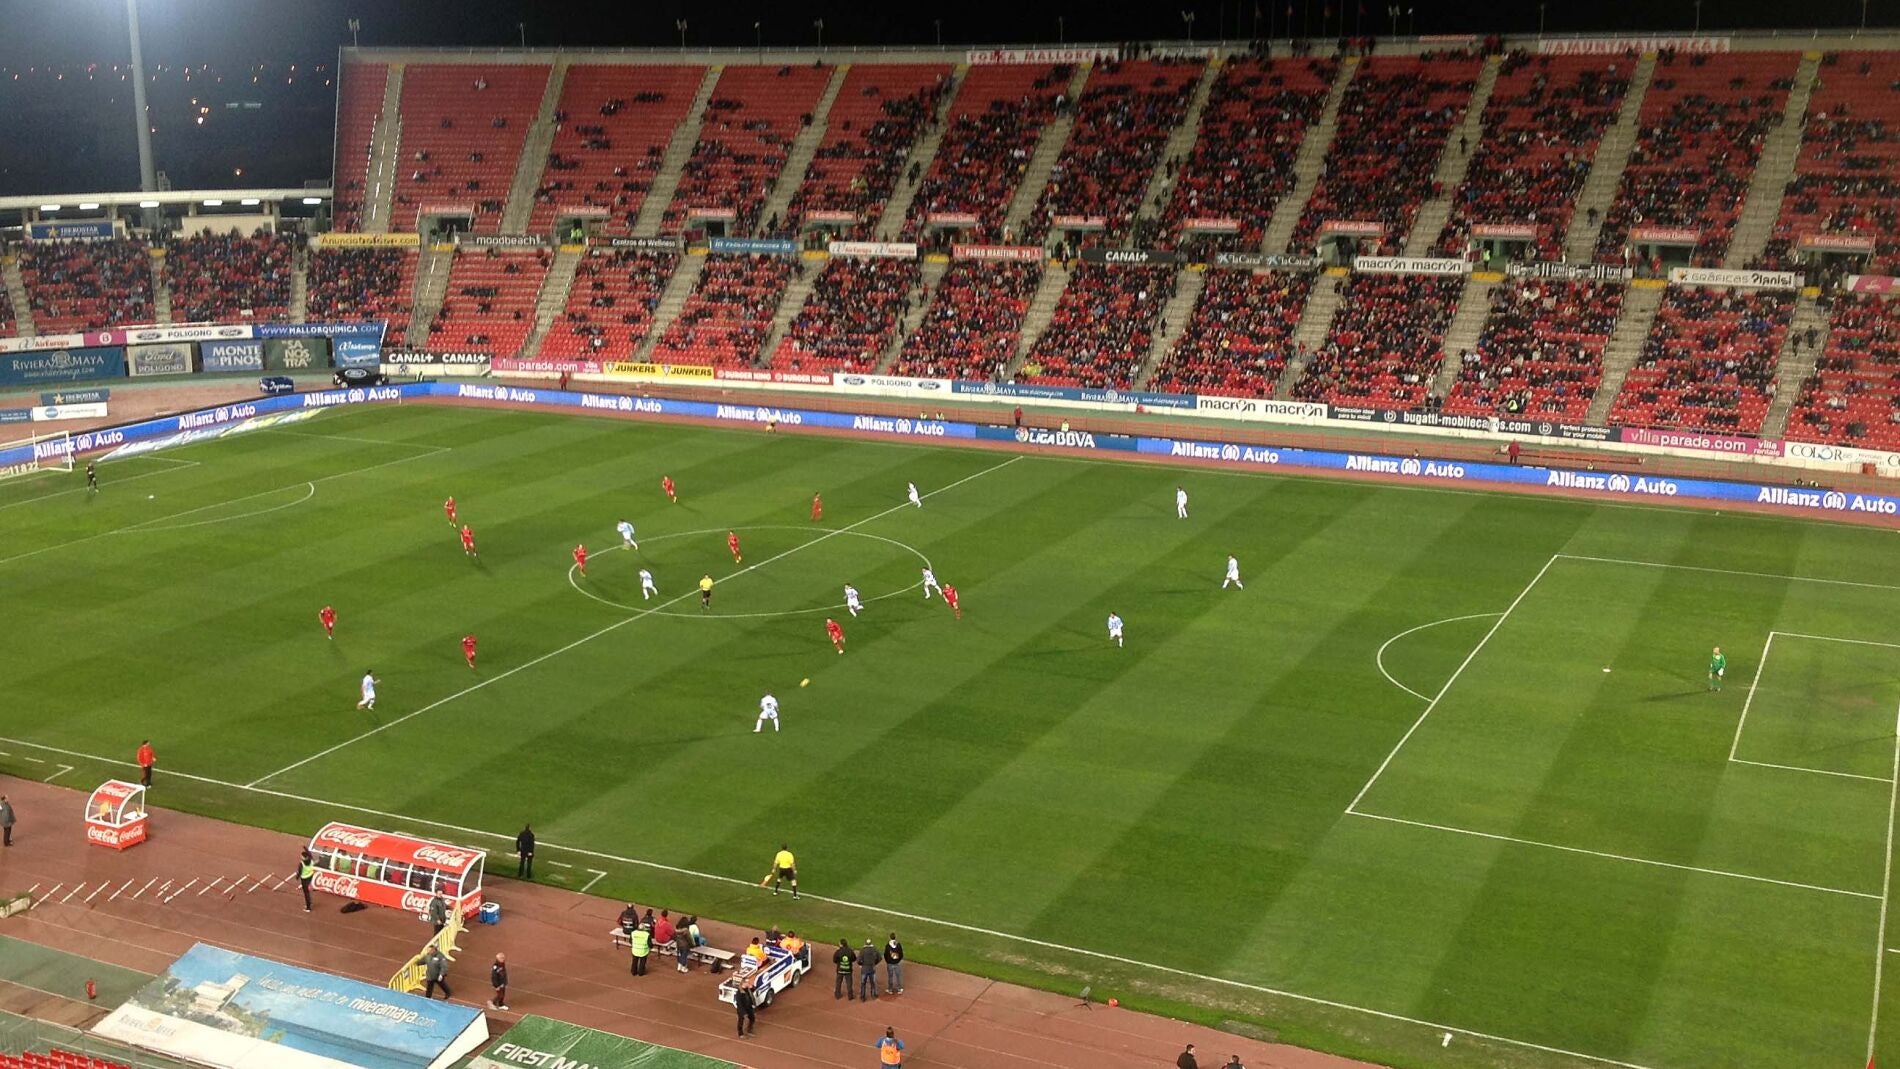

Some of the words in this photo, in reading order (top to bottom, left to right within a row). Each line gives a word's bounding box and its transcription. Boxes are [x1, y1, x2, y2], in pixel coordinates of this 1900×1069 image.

[476, 235, 536, 246] moodbeach
[1105, 251, 1149, 262] CANAL+
[1358, 259, 1406, 271] macron
[1411, 260, 1461, 272] macron
[212, 344, 261, 357] MONTE
[284, 349, 310, 359] NOS
[388, 353, 434, 363] CANAL+
[442, 353, 487, 363] CANAL+
[71, 354, 105, 367] MAYA
[614, 364, 656, 374] JUNKERS
[670, 366, 713, 377] JUNKERS
[753, 372, 771, 381] KING
[871, 378, 912, 388] POLIGONO
[303, 391, 346, 407] Allianz
[368, 387, 400, 401] Auto
[459, 384, 494, 400] Allianz
[510, 388, 536, 402] Auto
[581, 394, 617, 410] Allianz
[634, 398, 662, 413] Auto
[1200, 398, 1256, 412] macron
[1265, 402, 1323, 417] macron
[178, 409, 214, 430] Allianz
[231, 405, 256, 420] Auto
[717, 405, 755, 421] Allianz
[774, 410, 802, 424] Auto
[853, 416, 894, 432] Allianz
[914, 420, 945, 436] Auto
[34, 441, 76, 459] Allianz
[95, 431, 124, 447] Auto
[1630, 429, 1746, 451] villaparade.com
[1757, 439, 1777, 449] villa
[1171, 440, 1219, 458] Allianz
[1242, 449, 1279, 464] Auto
[1791, 444, 1843, 461] COLOR
[1346, 455, 1399, 474] Allianz
[1423, 461, 1465, 479] Auto
[1546, 470, 1605, 490] Allianz
[1633, 477, 1677, 496] Auto
[1757, 486, 1820, 508] Allianz
[1850, 494, 1898, 515] Auto
[320, 827, 380, 848] Coca-Cola
[412, 845, 476, 867] Coca-Cola
[311, 870, 360, 897] Coca-Cola
[492, 1042, 557, 1066] FIRST
